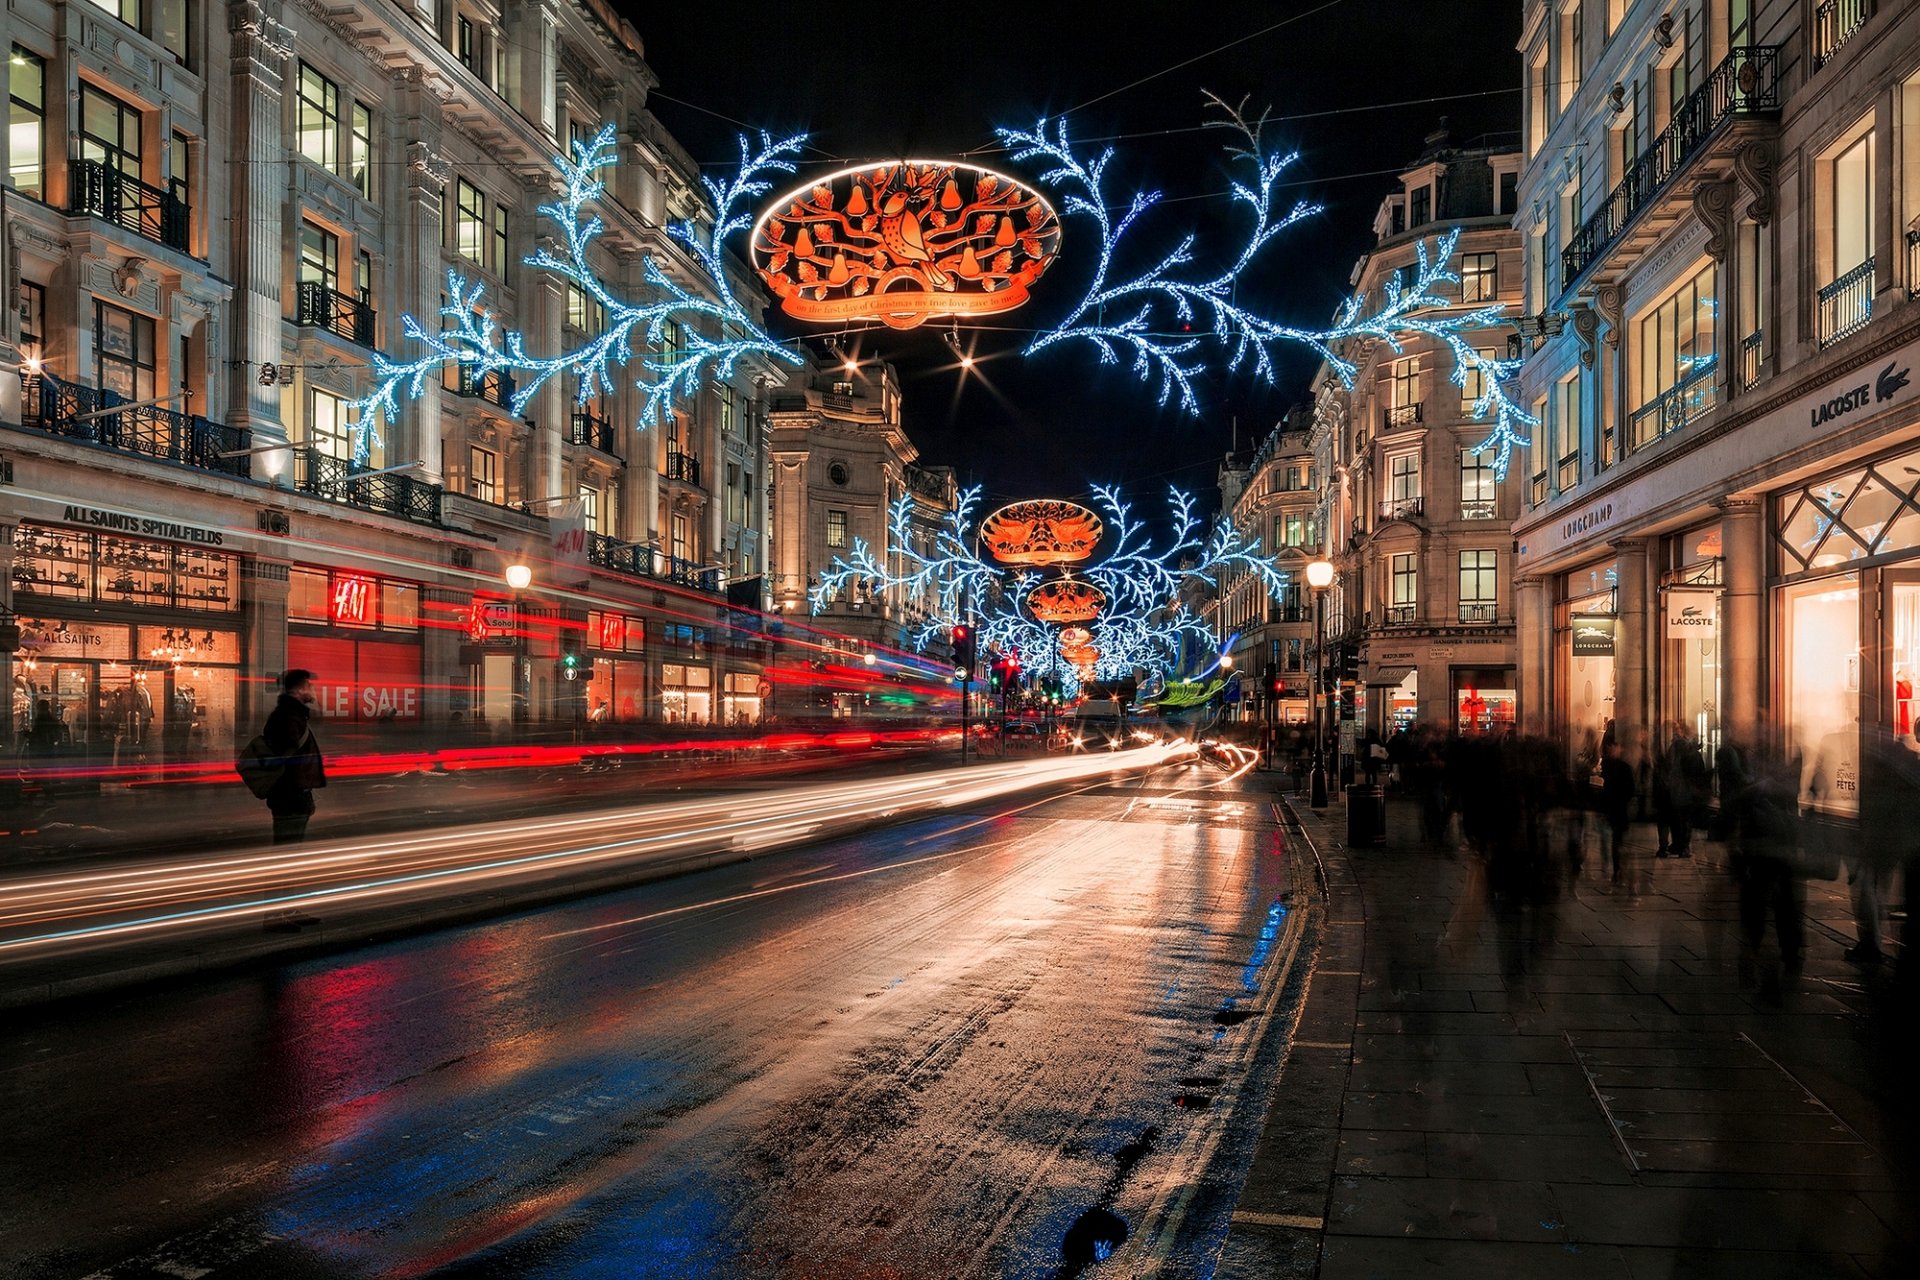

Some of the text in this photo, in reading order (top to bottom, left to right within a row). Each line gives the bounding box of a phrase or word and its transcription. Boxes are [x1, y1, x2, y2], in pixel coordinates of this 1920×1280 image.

[808, 304, 820, 313] the
[824, 304, 840, 313] first
[843, 303, 858, 314] day
[860, 302, 869, 310] of
[870, 299, 912, 309] Christmas
[949, 298, 966, 307] love
[1811, 383, 1870, 428] LACOSTE
[63, 505, 223, 546] ALLSAINTS SPITALFIELDS
[1563, 503, 1613, 540] LONGCHAMP
[492, 619, 512, 627] Soho
[1670, 618, 1713, 626] LACOSTE
[43, 632, 102, 646] ALLSAINTS
[167, 639, 214, 651] ALLSAINTS
[322, 686, 416, 718] LE SALE
